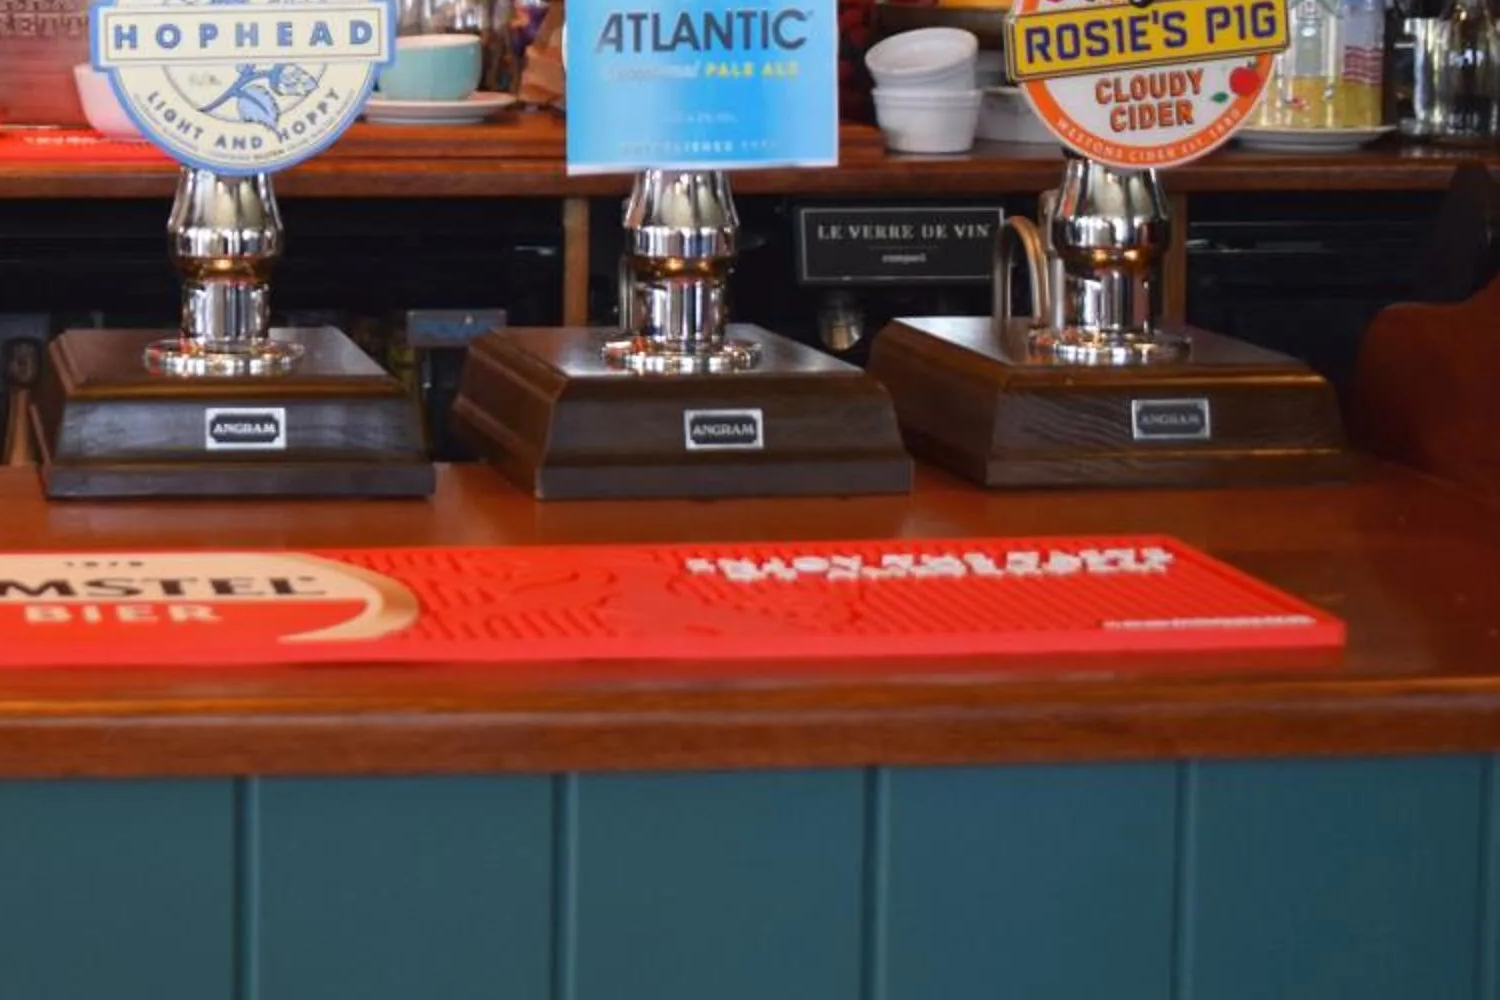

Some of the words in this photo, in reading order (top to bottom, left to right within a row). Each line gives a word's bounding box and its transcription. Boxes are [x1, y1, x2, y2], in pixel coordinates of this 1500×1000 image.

[112, 20, 374, 51] HOPHEAD
[594, 8, 808, 54] ATLANTIC
[706, 61, 755, 78] PALE
[760, 61, 799, 79] ALE
[1094, 67, 1205, 105] CLOUDY
[147, 91, 204, 141] LIGHT
[214, 135, 264, 150] AND
[276, 88, 341, 144] HOPPY
[1109, 99, 1194, 133] CIDER
[817, 224, 844, 240] LE
[849, 224, 915, 240] VERRE
[921, 223, 948, 239] DE
[953, 223, 992, 239] VIN
[213, 422, 277, 436] ANGRAM
[692, 423, 756, 437] ANGRAM
[23, 602, 222, 625] BIER
